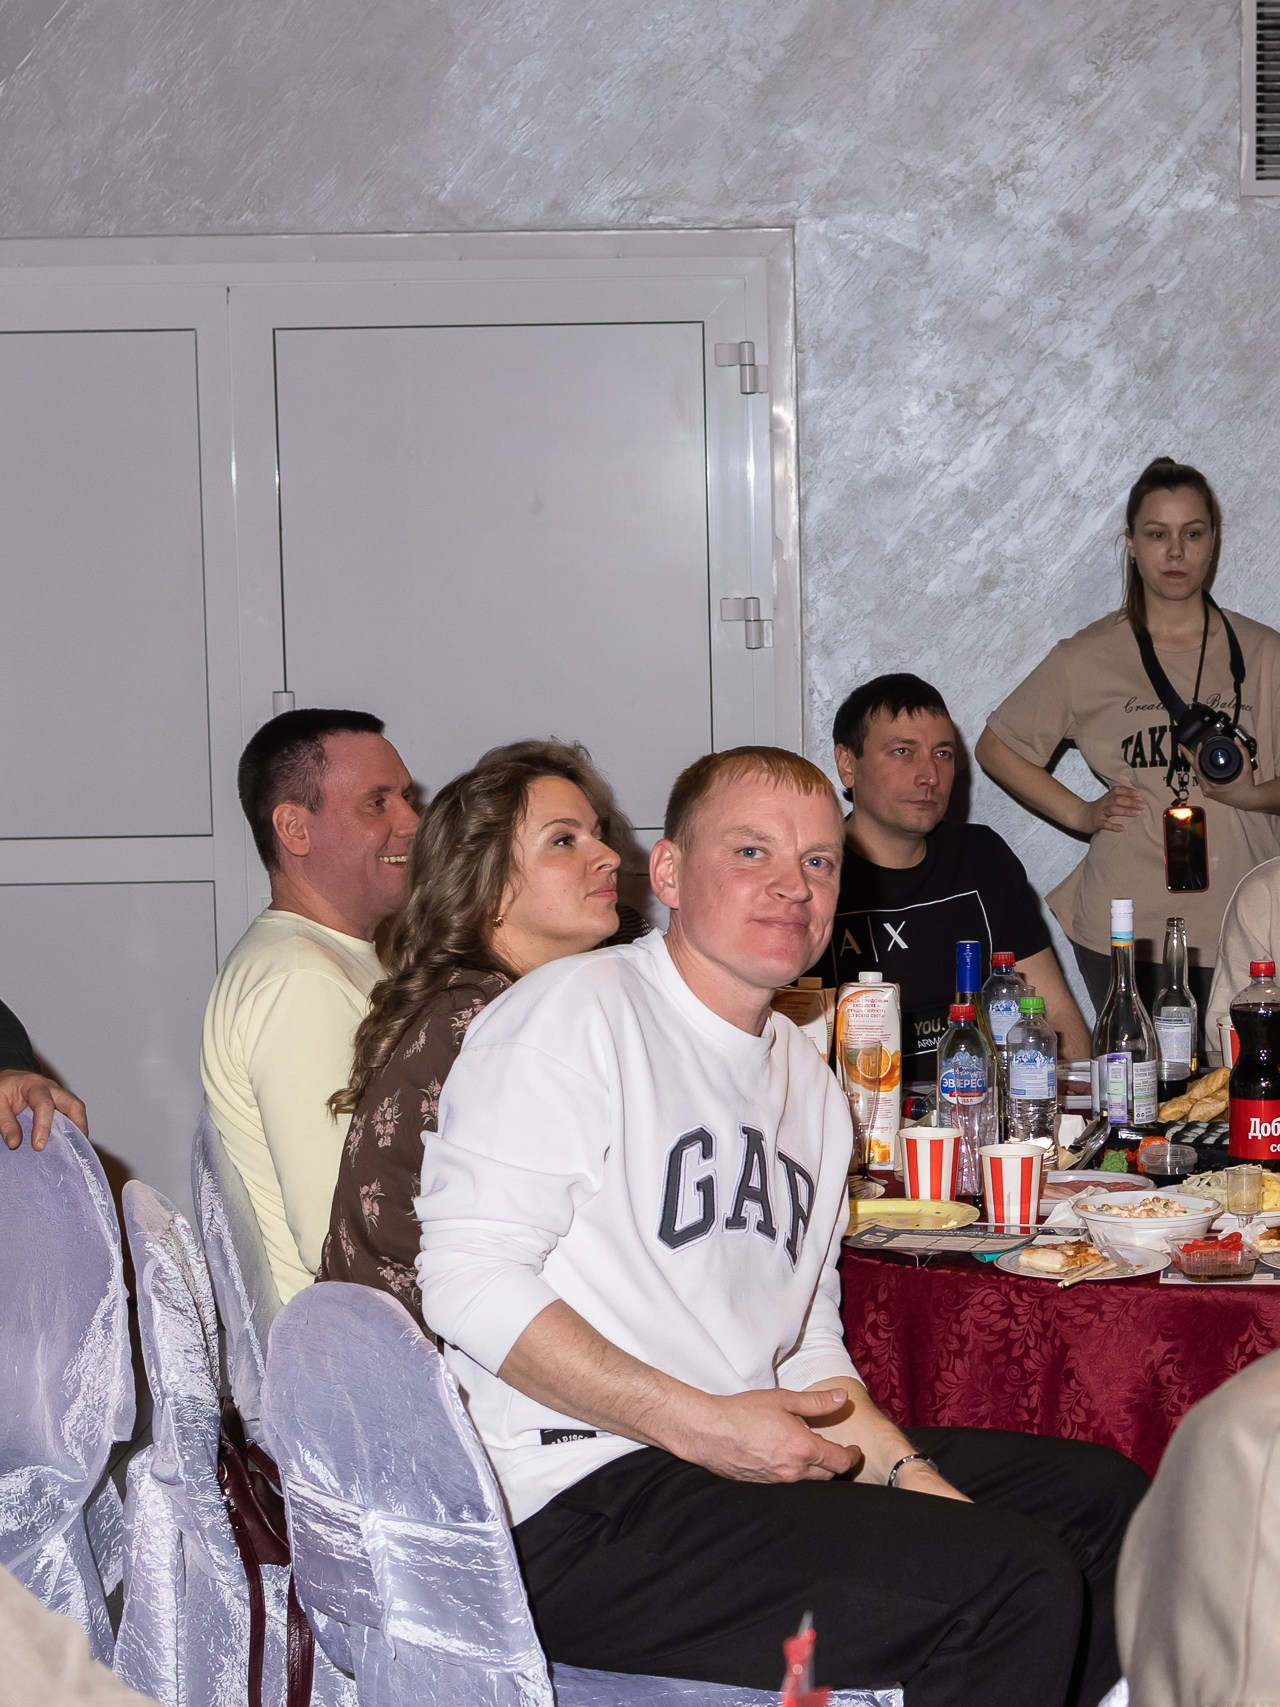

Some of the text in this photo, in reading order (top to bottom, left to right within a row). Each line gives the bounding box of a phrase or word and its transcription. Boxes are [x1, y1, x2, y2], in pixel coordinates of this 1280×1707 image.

[1206, 693, 1253, 712] Balnce
[1121, 725, 1172, 769] TAK
[882, 920, 909, 952] X
[657, 1126, 815, 1267] GAP
